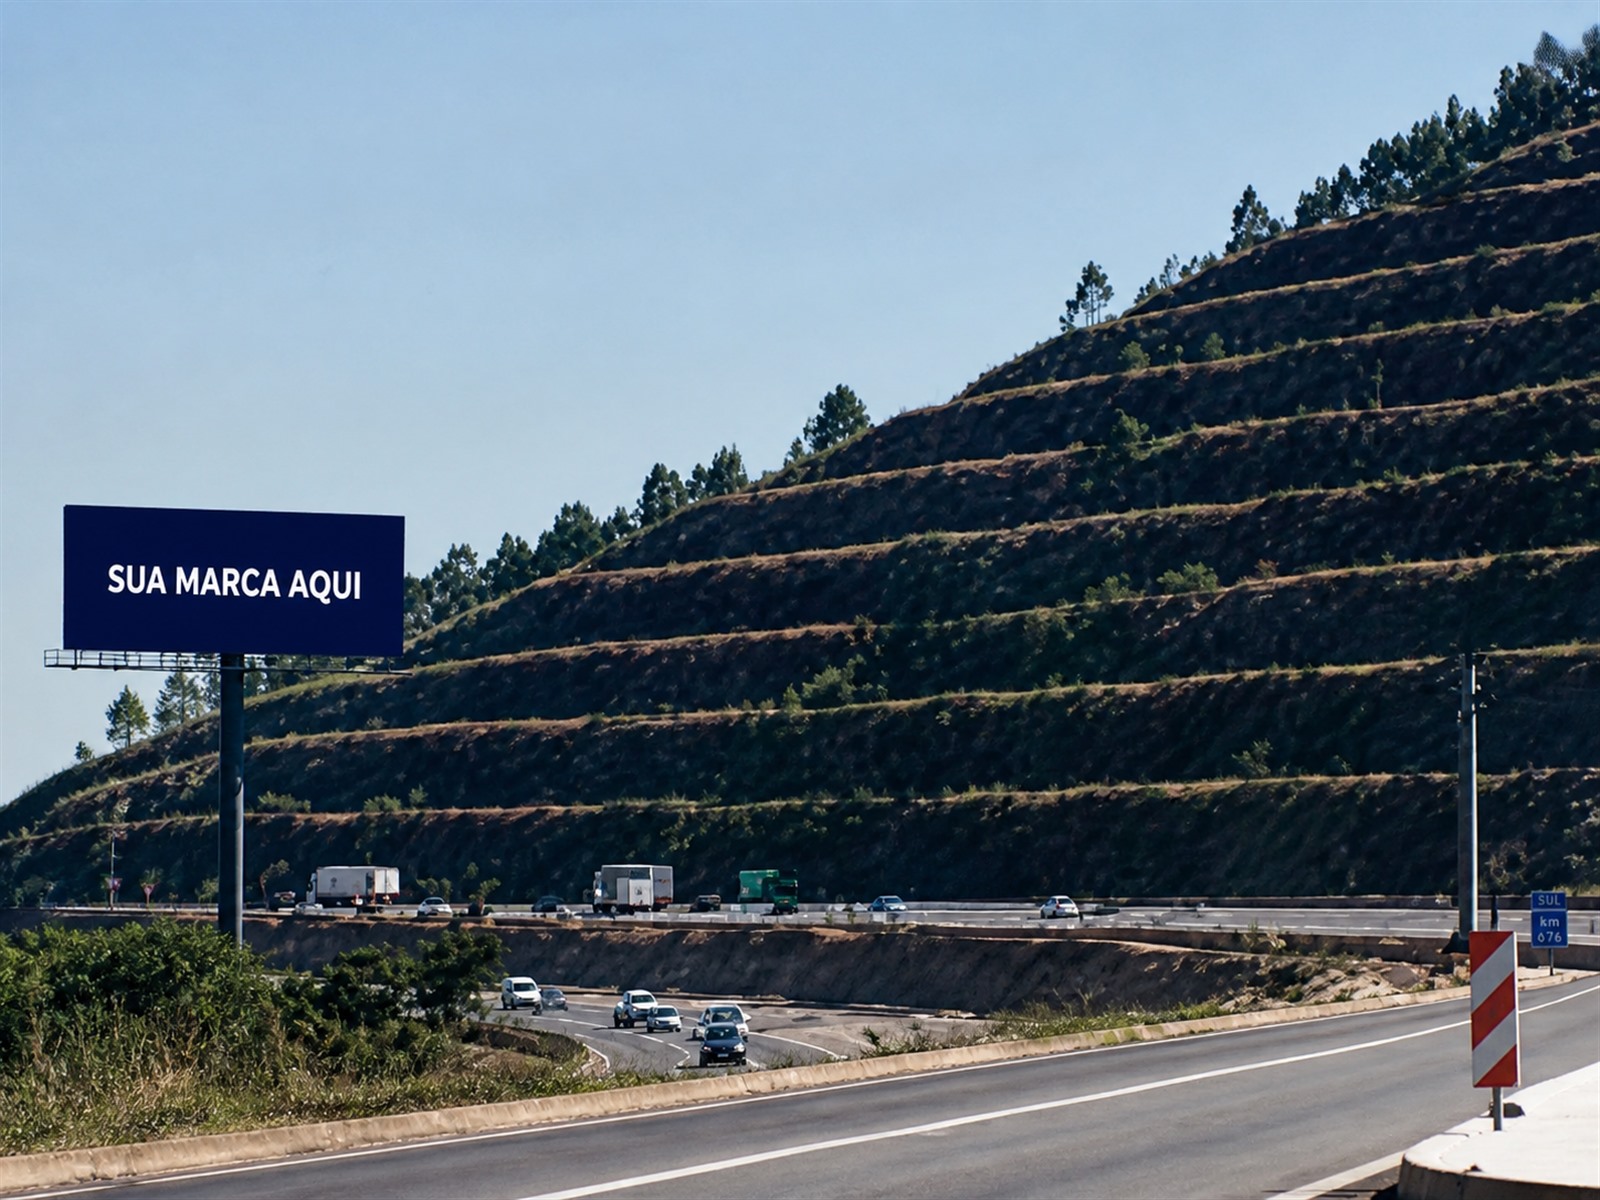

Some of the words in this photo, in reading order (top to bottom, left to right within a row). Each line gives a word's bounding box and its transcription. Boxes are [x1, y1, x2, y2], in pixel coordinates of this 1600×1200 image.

[108, 564, 166, 594] SUA
[176, 567, 281, 597] MARCA
[288, 570, 360, 604] AQUI
[1538, 895, 1560, 905] SUL
[1540, 916, 1560, 927] km
